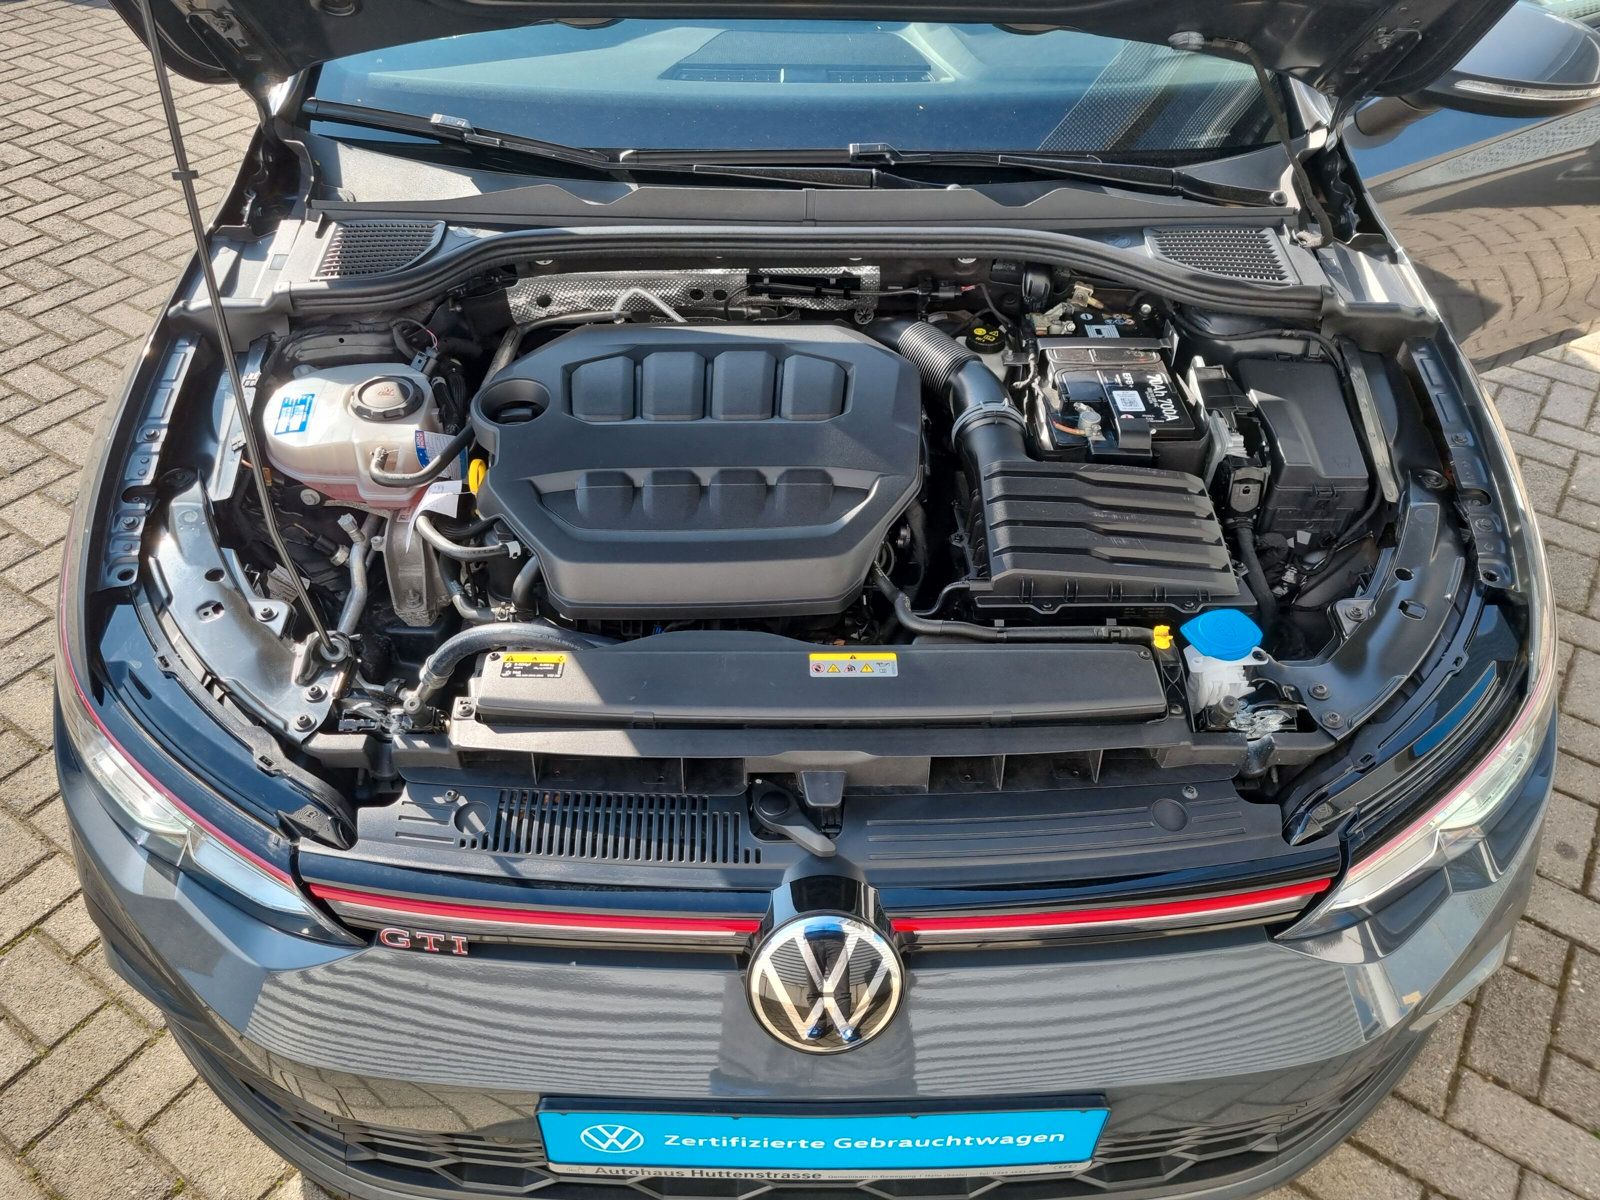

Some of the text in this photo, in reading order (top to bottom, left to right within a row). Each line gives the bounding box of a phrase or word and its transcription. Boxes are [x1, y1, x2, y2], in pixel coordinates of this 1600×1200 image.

[1146, 373, 1168, 397] 70Ah
[1158, 398, 1180, 422] 700A
[380, 927, 468, 956] GTI
[664, 1134, 826, 1149] Zertifizierte
[833, 1132, 1065, 1149] Gebrauchtwagen
[594, 1166, 685, 1177] Autohaus
[691, 1169, 822, 1179] Huttenstrasse
